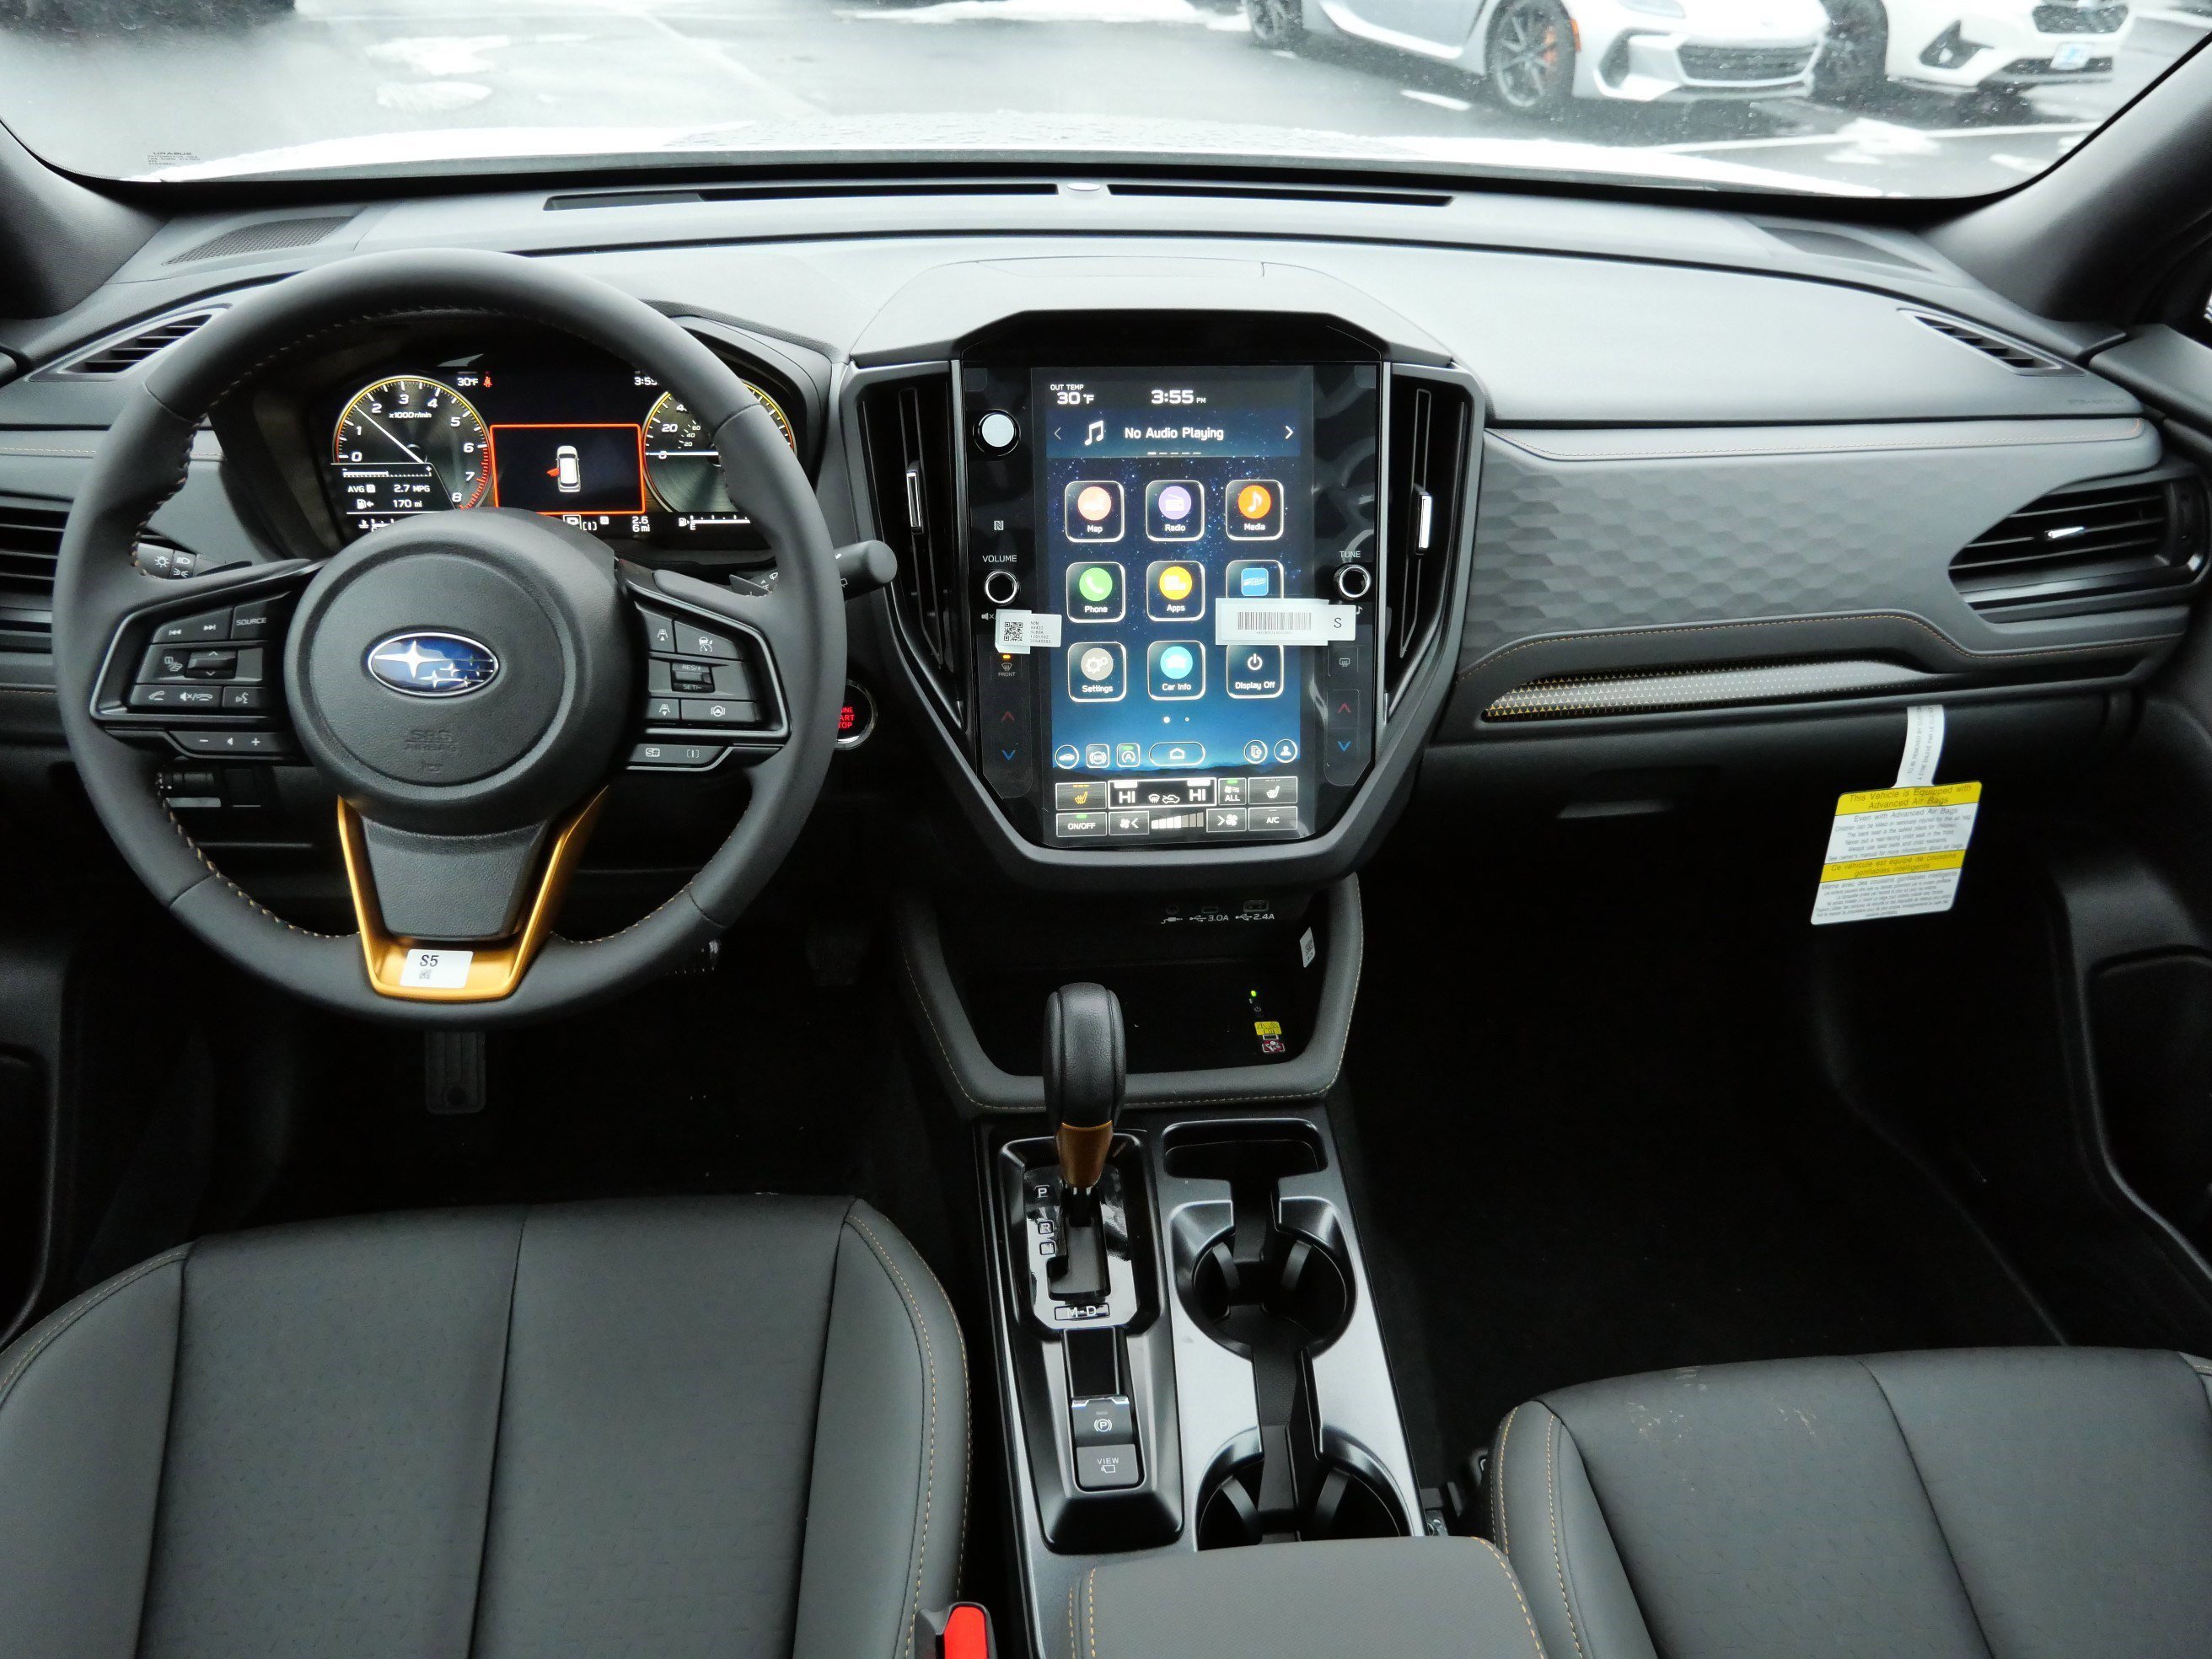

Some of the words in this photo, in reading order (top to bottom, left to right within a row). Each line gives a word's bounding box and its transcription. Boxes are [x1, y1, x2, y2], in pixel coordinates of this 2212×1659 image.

[457, 378, 479, 387] 30°F
[399, 394, 410, 405] 3
[1057, 392, 1081, 405] 30
[1151, 389, 1195, 405] 3:55
[371, 403, 383, 414] 2
[427, 399, 438, 408] 4
[450, 417, 461, 427] 5
[356, 426, 362, 436] 1
[662, 423, 679, 433] 20
[1125, 427, 1141, 439] No
[1146, 427, 1178, 439] Audio
[1182, 427, 1224, 441] Playing
[464, 443, 475, 454] 6
[351, 452, 362, 463] 0
[465, 471, 475, 482] 7
[347, 485, 365, 493] AVG
[394, 484, 411, 493] 2.7
[413, 485, 431, 493] MPG
[452, 492, 462, 502] 8
[393, 500, 412, 508] 170
[1087, 524, 1103, 534] Map
[1164, 523, 1186, 532] Radio
[1243, 522, 1266, 531] Media
[982, 555, 1017, 563] VOLUME
[1339, 550, 1361, 559] TUNE
[1084, 604, 1109, 614] Phone
[1167, 604, 1185, 614] Apps
[235, 616, 267, 627] SOURCE
[1334, 617, 1342, 629] S
[1082, 684, 1114, 695] Settings
[1162, 683, 1173, 691] Car
[1175, 683, 1192, 691] Info
[1235, 680, 1261, 691] Display
[1263, 680, 1276, 689] Off
[1118, 791, 1136, 803] HI
[1189, 789, 1206, 802] HI
[1870, 790, 1899, 801] Vehicle
[1914, 786, 1952, 797] Equipped
[1868, 798, 1909, 809] Advanced
[1912, 797, 1924, 806] Air
[1927, 797, 1949, 806] Bags
[1854, 814, 1871, 823] Even
[1891, 809, 1925, 818] Advanced
[1067, 822, 1096, 830] ON/OFF
[420, 954, 440, 968] S5
[1038, 1188, 1047, 1198] P
[1041, 1224, 1050, 1232] R
[1097, 1457, 1119, 1465] VIEW
